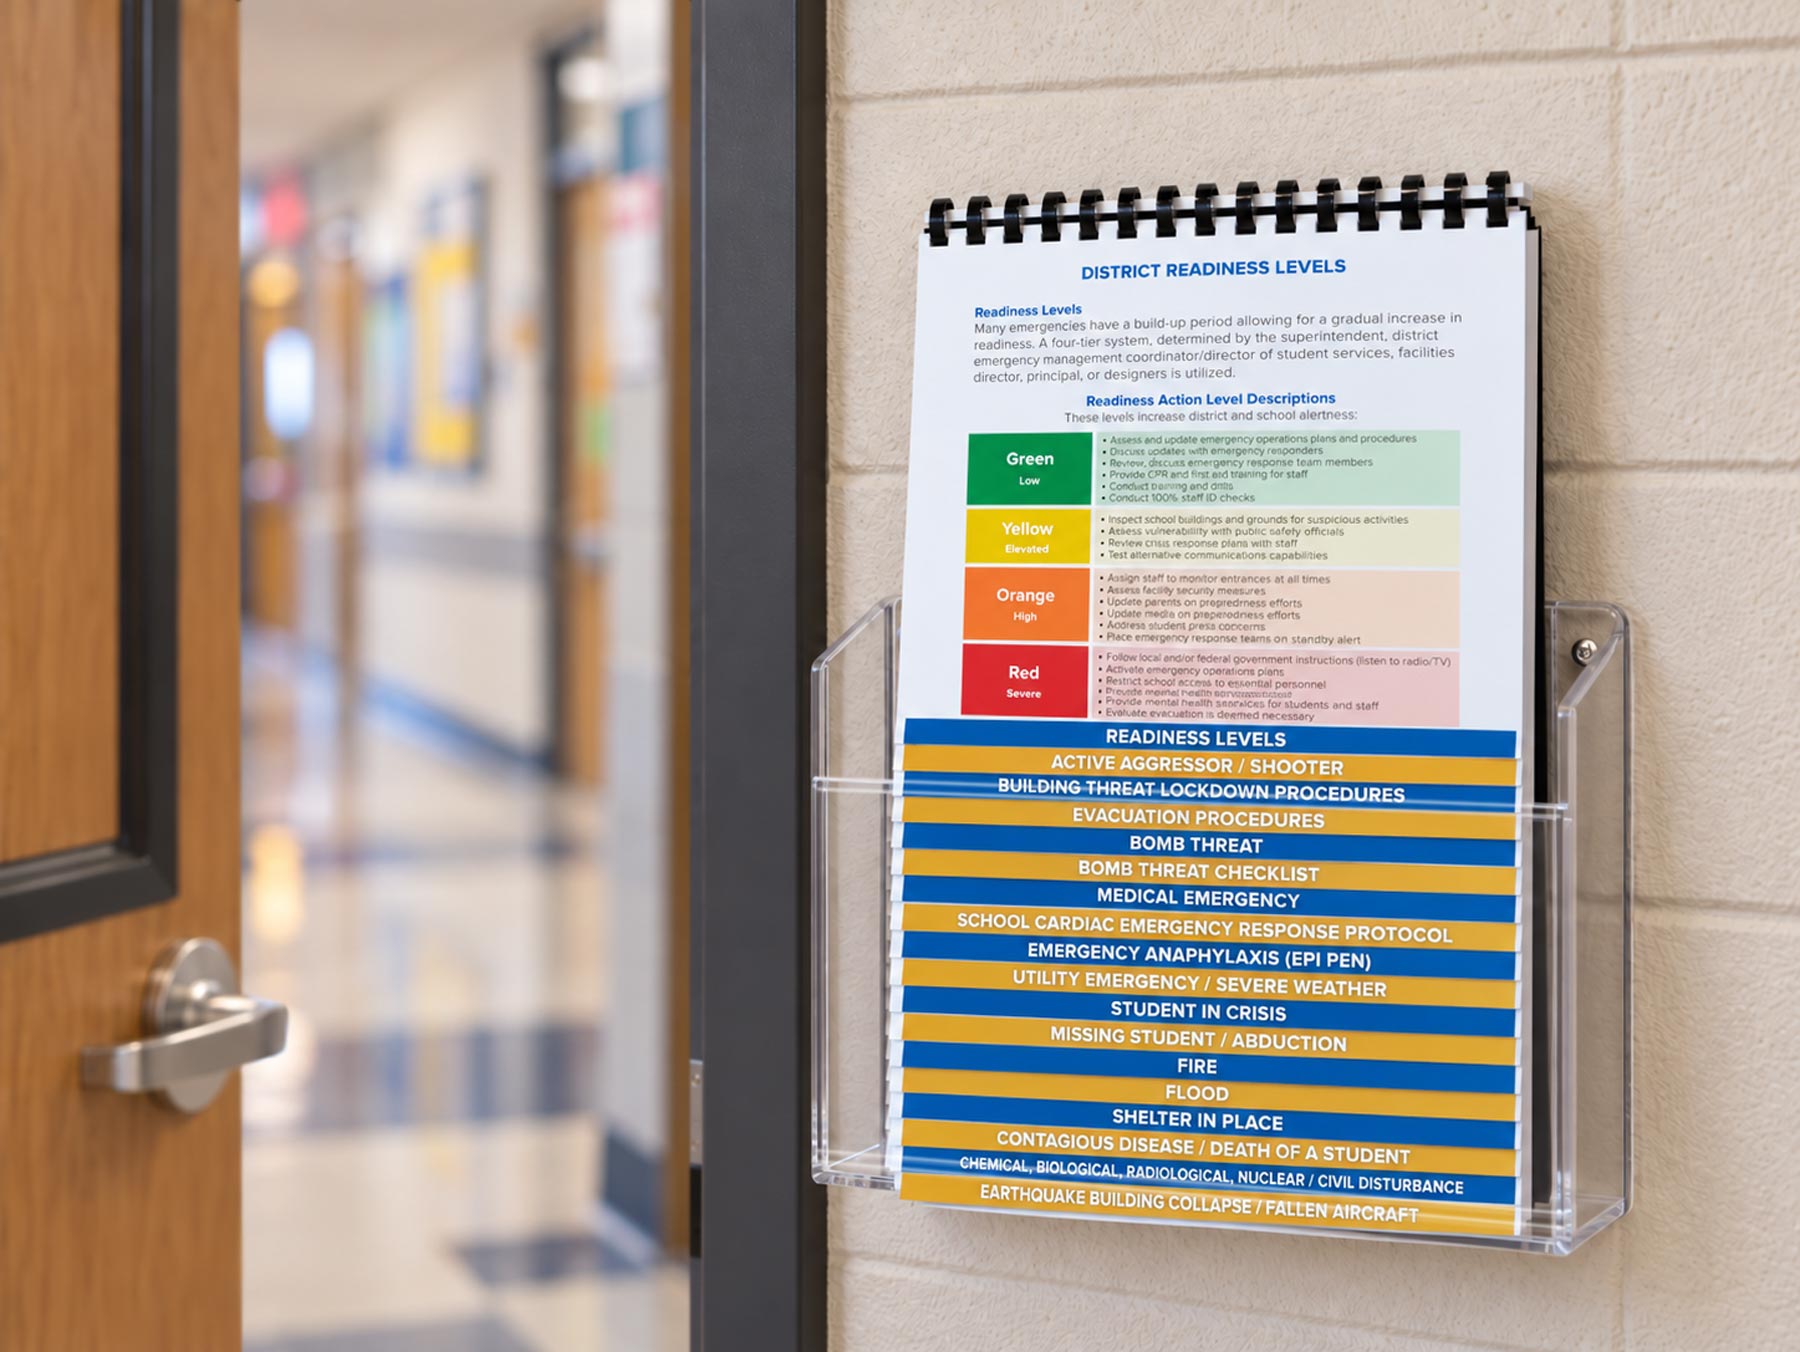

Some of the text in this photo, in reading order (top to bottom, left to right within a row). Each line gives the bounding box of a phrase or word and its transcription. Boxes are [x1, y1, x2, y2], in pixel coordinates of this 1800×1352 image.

[1082, 259, 1346, 280] DISTRICT READINESS LEVELS
[975, 303, 1081, 317] Readiness Levels
[974, 312, 1462, 335] Many emergencies have a build-up period allowing for a gradual increase in
[974, 330, 1438, 350] readiness. A four-tier system, determined by the superintendent, district
[973, 346, 1454, 368] emergency management coordinator/director of student services, facilities
[973, 366, 1235, 383] director, principal, or designers is utilized.
[1086, 392, 1335, 406] Readiness Action Level Descriptions
[1064, 409, 1357, 423] These levels increase district and school alertness:
[1006, 452, 1054, 465] Green
[1019, 476, 1040, 485] Low
[1181, 492, 1204, 502] staff
[1219, 493, 1255, 502] checks
[1108, 515, 1142, 524] Inspect
[1144, 515, 1176, 524] school
[1225, 514, 1244, 524] and
[1246, 515, 1288, 525] grounds
[1290, 514, 1304, 524] for
[1307, 515, 1361, 524] suspicious
[1002, 522, 1053, 536] Yellow
[1005, 544, 1049, 553] Elevated
[1142, 573, 1164, 583] staff
[1166, 574, 1176, 583] to
[1274, 575, 1284, 583] at
[1287, 575, 1299, 583] all
[1301, 575, 1330, 584] times
[996, 587, 1054, 605] Orange
[1013, 611, 1037, 623] High
[1233, 655, 1292, 665] government
[1295, 655, 1353, 665] instructions
[1356, 656, 1386, 666] (listen
[1389, 657, 1400, 666] to
[1402, 656, 1451, 667] radio/TV)
[1009, 665, 1039, 679] Red
[1006, 688, 1041, 698] Severe
[1106, 728, 1286, 747] READINESS LEVELS
[1051, 754, 1343, 775] ACTIVE AGGRESSOR / SHOOTER
[998, 778, 1405, 803] BUILDING THREAT LOCKDOWN PROCEDURES
[1073, 807, 1324, 828] EVACUATION PROCEDURES
[1130, 835, 1263, 853] BOMB THREAT
[1079, 859, 1319, 881] BOMB THREAT CHECKLIST
[1097, 887, 1299, 908] MEDICAL EMERGENCY
[957, 912, 1452, 943] SCHOOL CARDIAC EMERGENCY RESPONSE PROTOCOL
[1028, 942, 1370, 971] EMERGENCY ANAPHYLAXIS (EPI PEN)
[1013, 969, 1386, 996] UTILITY EMERGENCY / SEVERE WEATHER
[1111, 1000, 1286, 1021] STUDENT IN CRISIS
[1051, 1025, 1346, 1051] MISSING STUDENT / ABDUCTION
[1178, 1057, 1216, 1074] FIRE
[1166, 1084, 1229, 1101] FLOOD
[1112, 1108, 1282, 1131] SHELTER IN PLACE
[997, 1130, 1410, 1164] CONTAGIOUS DISEASE / DEATH OF A STUDENT
[956, 1156, 1463, 1194] CHEMICAL, BIOLOGICAL, RADIOLOGICAL, NUCLEAR / CIVIL DISTURBANCE
[980, 1183, 1418, 1222] EARTHQUAKE BUILDING COLLAPSE / FALLEN AIRCRAFT
